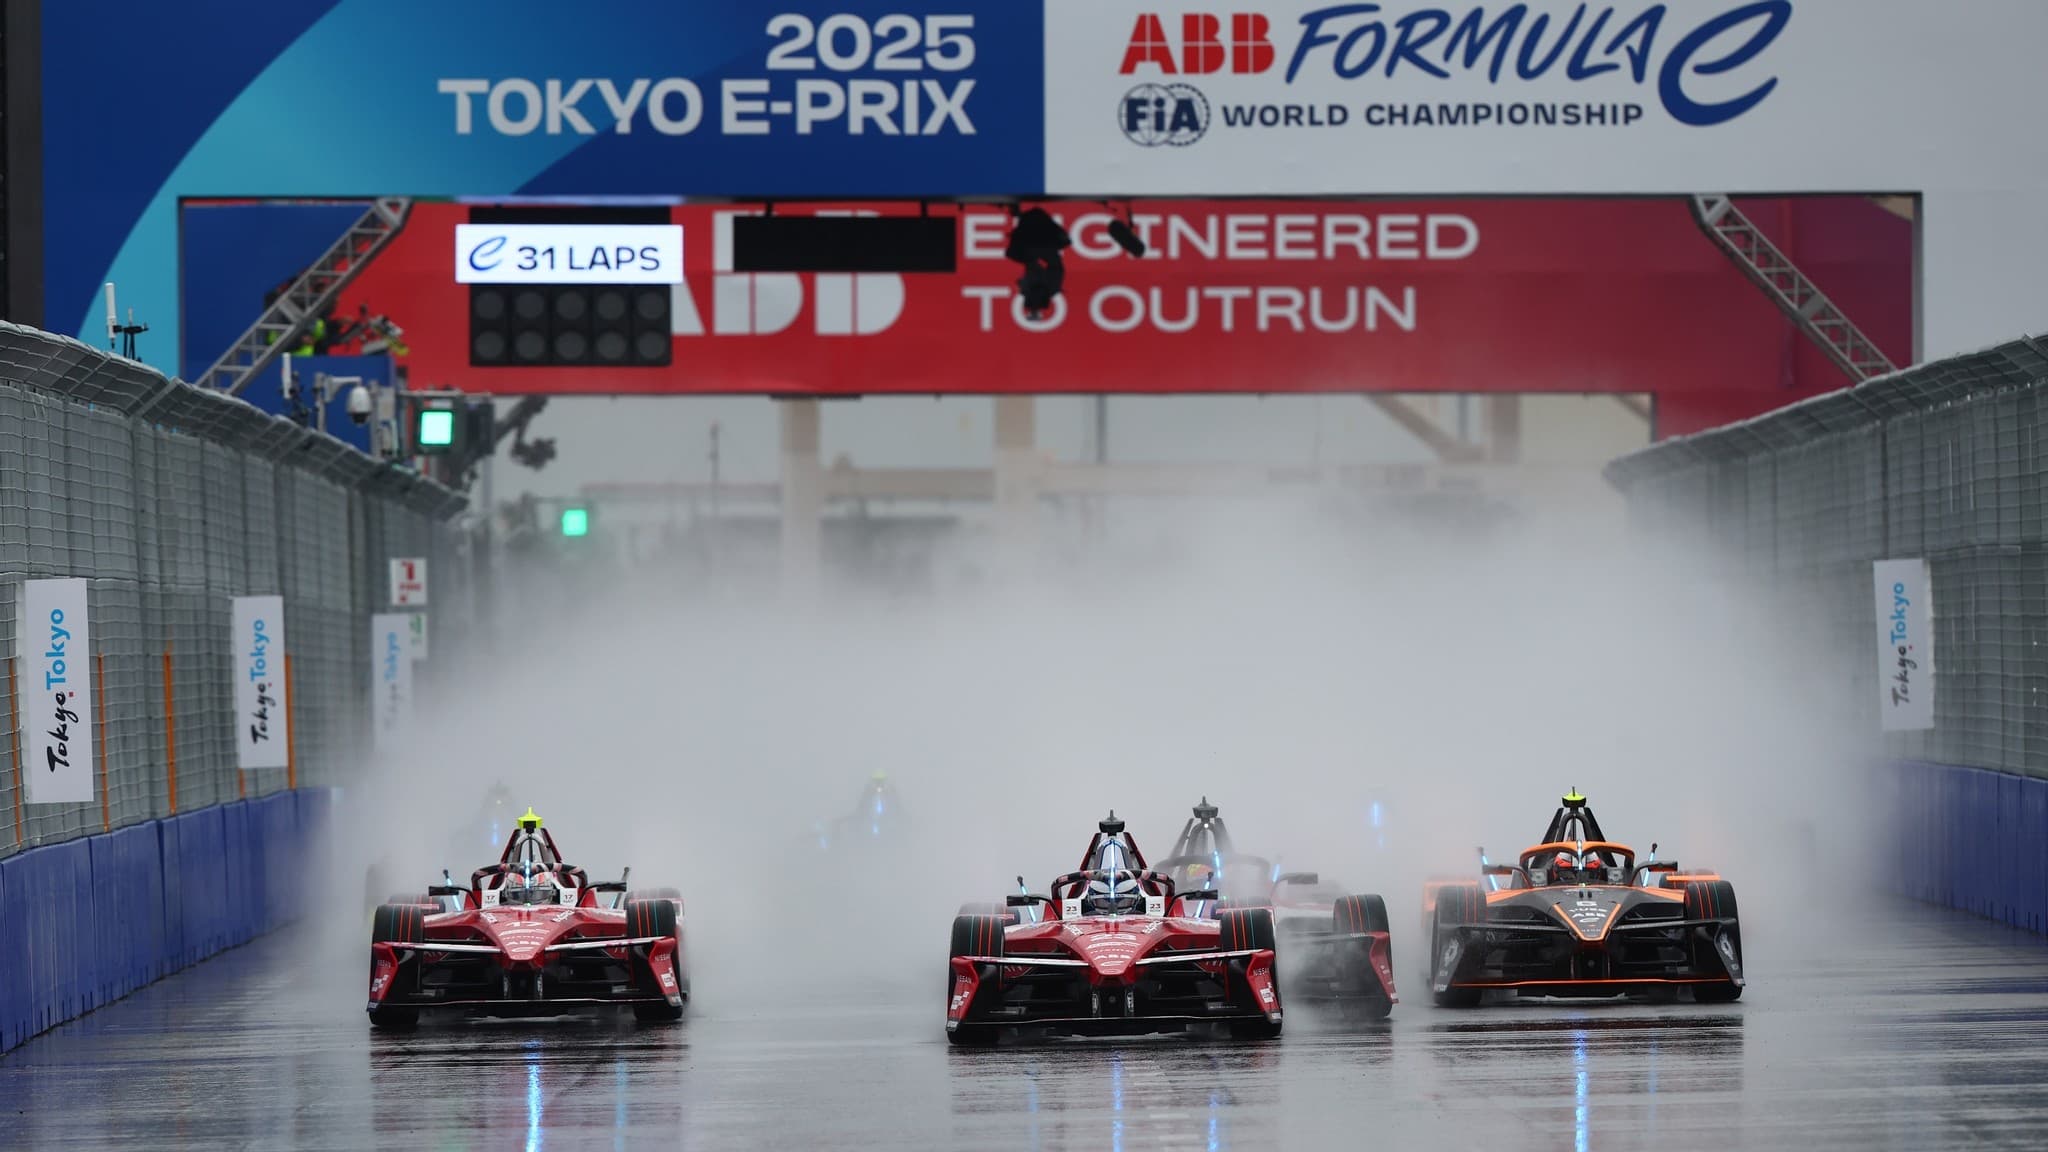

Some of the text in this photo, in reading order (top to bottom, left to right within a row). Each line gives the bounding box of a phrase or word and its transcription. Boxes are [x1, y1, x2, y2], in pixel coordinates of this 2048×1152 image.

[766, 14, 976, 71] 2025
[1119, 13, 1275, 75] ABB
[1285, 3, 1666, 85] FORMULA
[438, 78, 977, 136] TOKYO E-PRIX
[1222, 103, 1644, 127] WORLD CHAMPIONSHIP
[517, 246, 554, 271] 31
[569, 246, 660, 271] LAPS
[963, 212, 1480, 260] EGINEERED
[961, 285, 1416, 332] TO OUTRUN
[1890, 582, 1918, 707] Tokyo Tokyo
[45, 608, 79, 773] Tokyo Tokyo
[249, 619, 277, 744] Tokyo Tokyo
